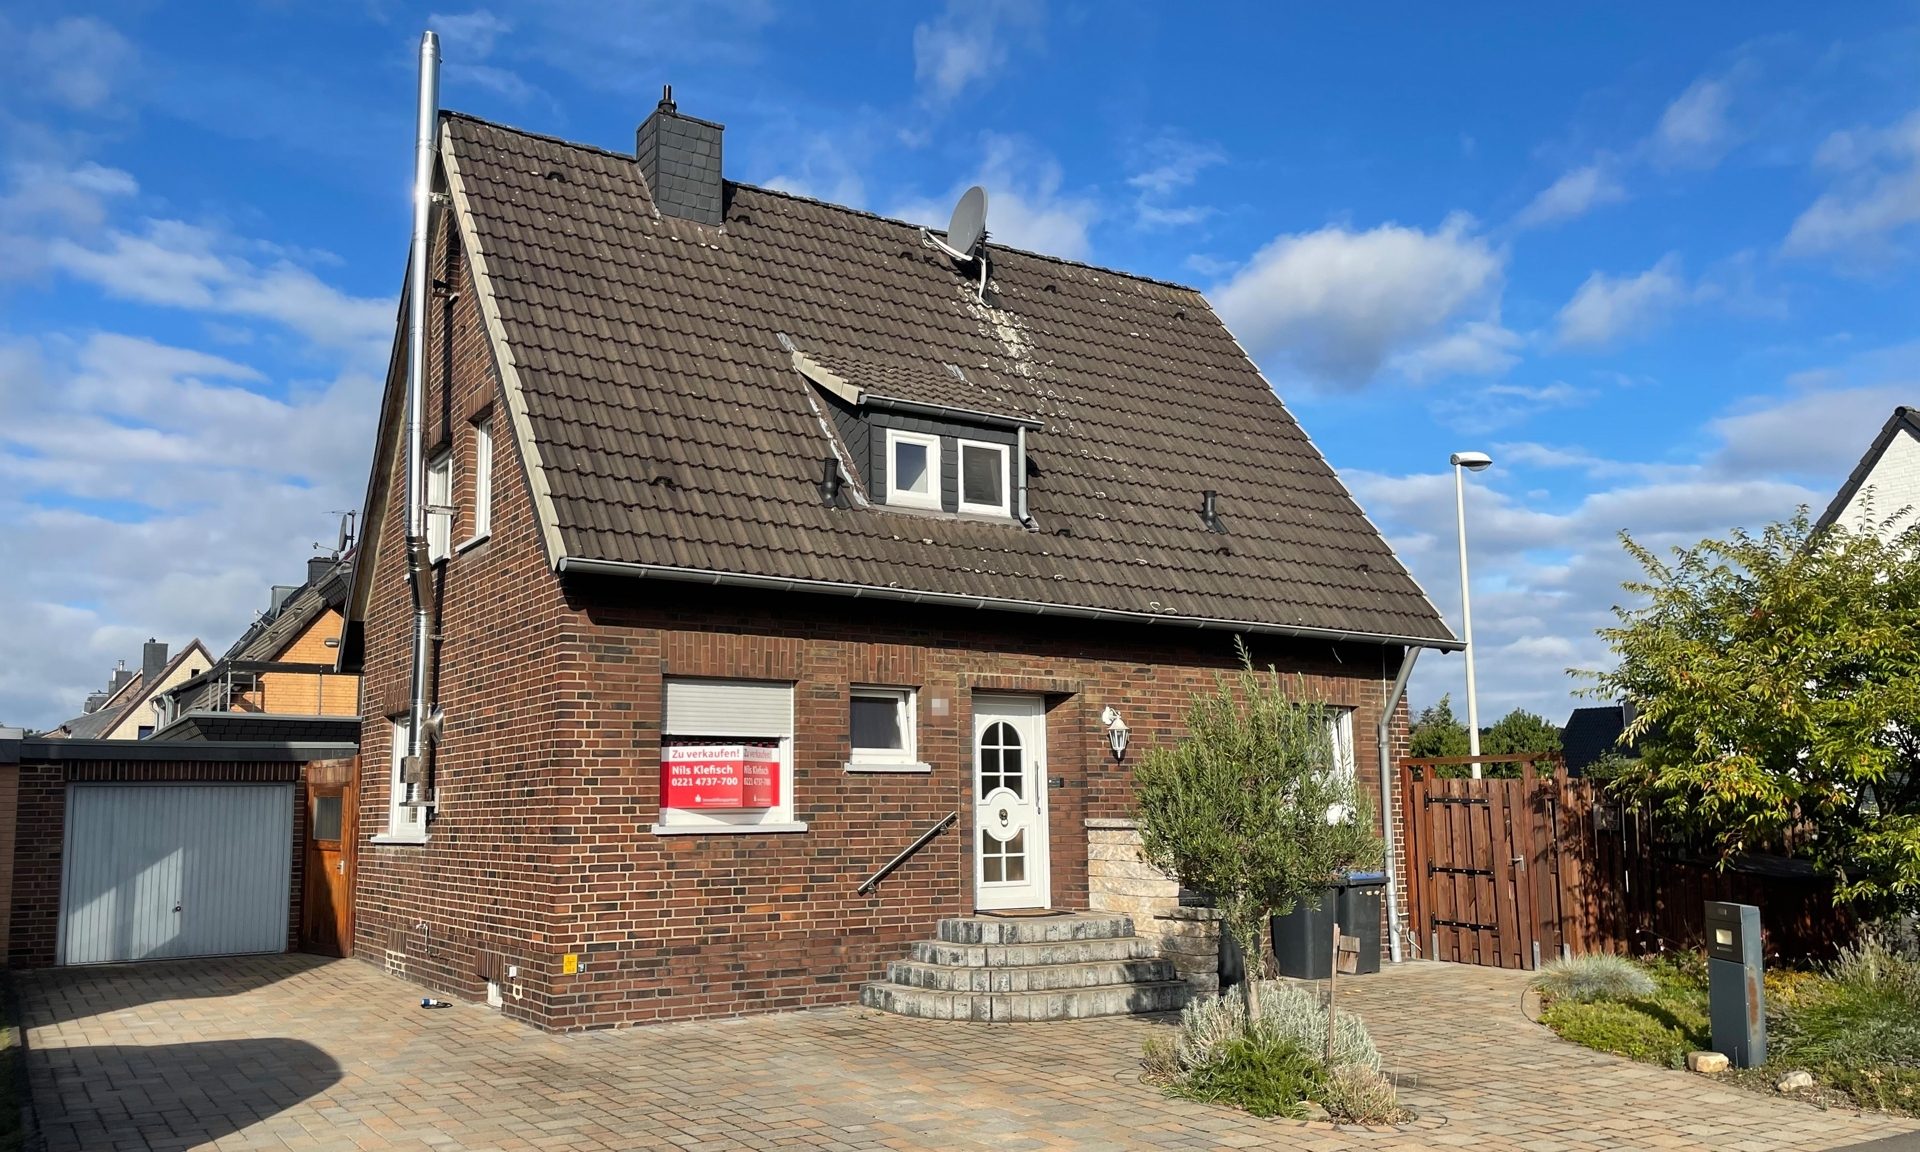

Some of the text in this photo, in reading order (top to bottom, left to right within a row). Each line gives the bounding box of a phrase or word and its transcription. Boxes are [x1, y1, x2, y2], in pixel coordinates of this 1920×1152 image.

[672, 750, 684, 758] Zu
[687, 749, 740, 758] verkaufen!
[672, 766, 691, 775] Nils
[694, 765, 733, 775] Klefisch
[672, 778, 693, 786] 0221
[695, 777, 738, 786] 4737-700
